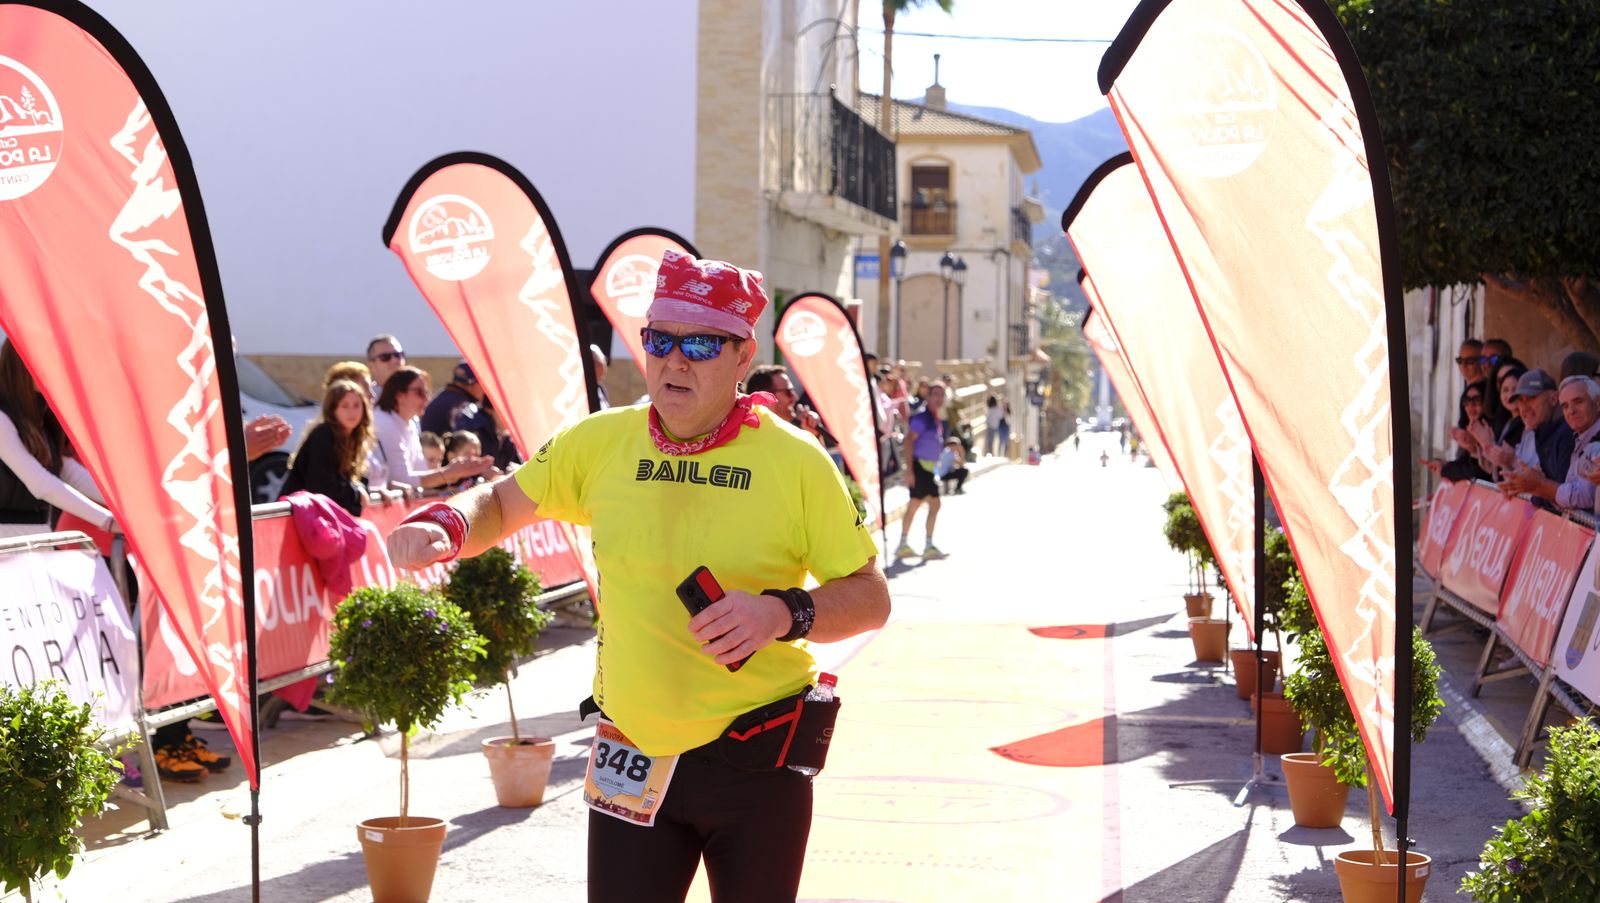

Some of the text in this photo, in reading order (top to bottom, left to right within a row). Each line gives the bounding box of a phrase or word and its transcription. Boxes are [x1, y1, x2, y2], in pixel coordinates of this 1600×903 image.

[685, 292, 713, 306] balance
[636, 459, 752, 490] BAILEN
[71, 593, 105, 622] DE
[254, 563, 324, 632] OLIA
[11, 629, 121, 693] ORIA
[595, 742, 652, 783] 348
